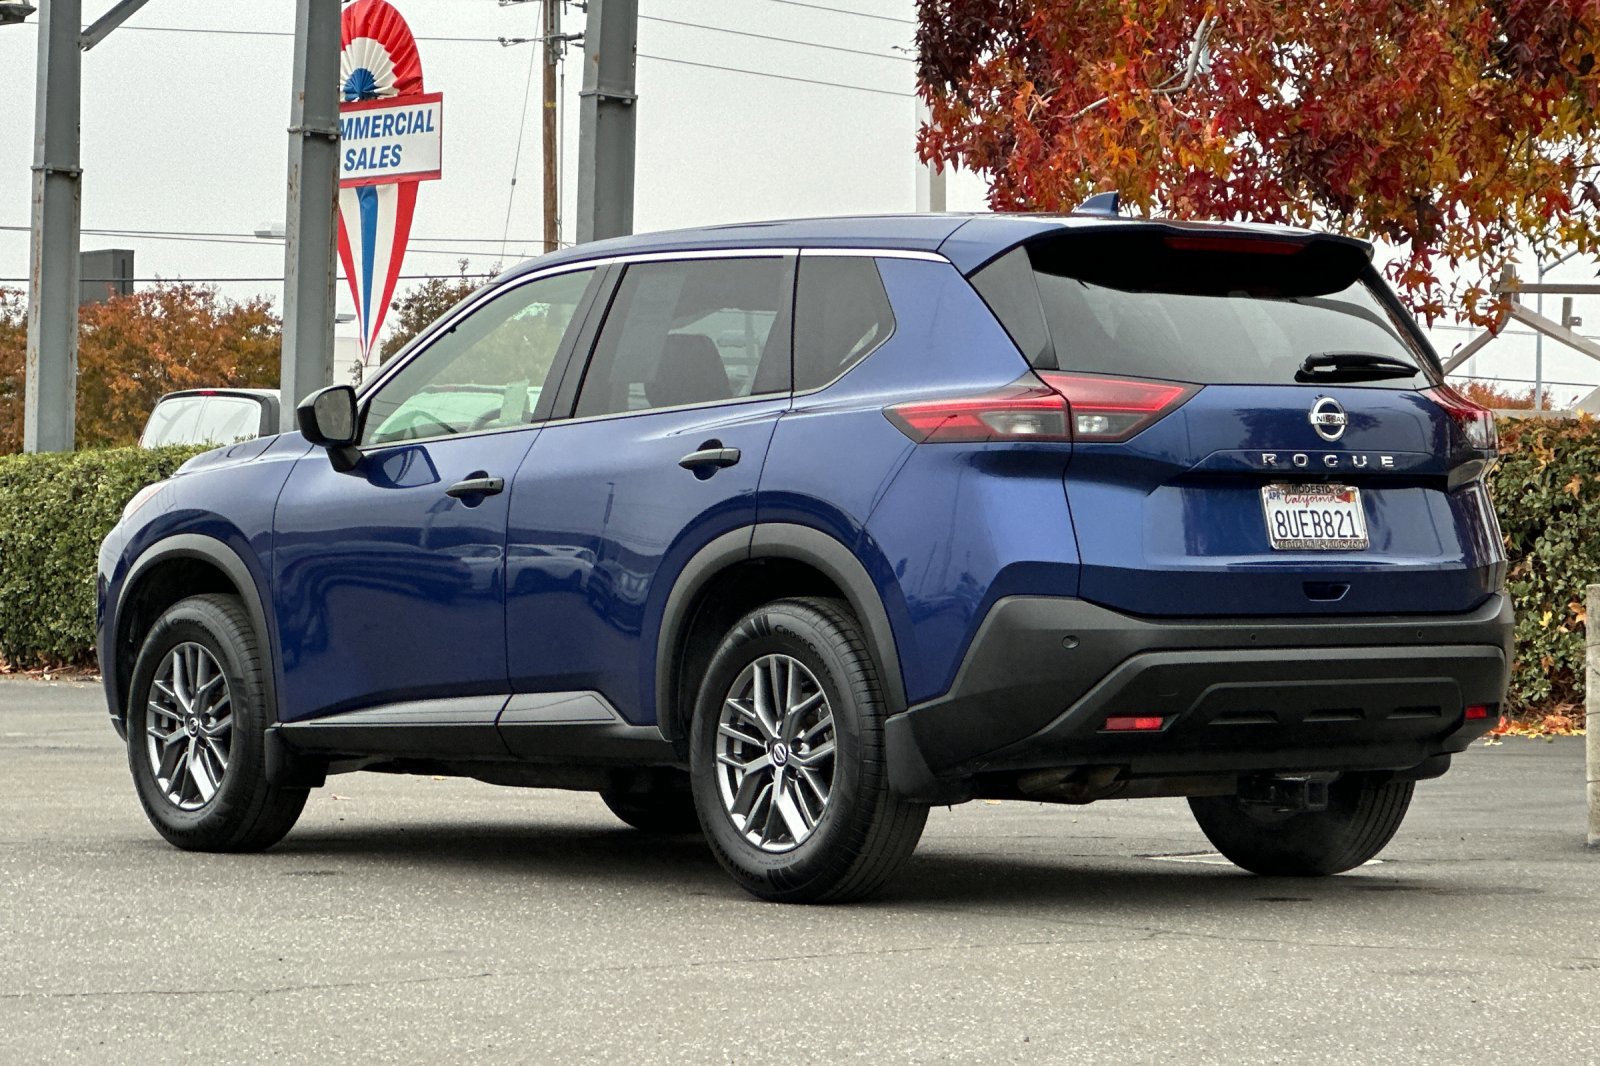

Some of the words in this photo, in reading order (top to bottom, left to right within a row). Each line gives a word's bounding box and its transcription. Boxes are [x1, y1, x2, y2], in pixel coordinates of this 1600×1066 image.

[339, 109, 434, 140] MMERCIAL
[344, 144, 402, 171] SALES
[1316, 414, 1346, 423] NISSAN
[1262, 453, 1395, 468] ROGUE
[1291, 484, 1332, 494] MODESTO
[1275, 510, 1359, 538] 8UEB821
